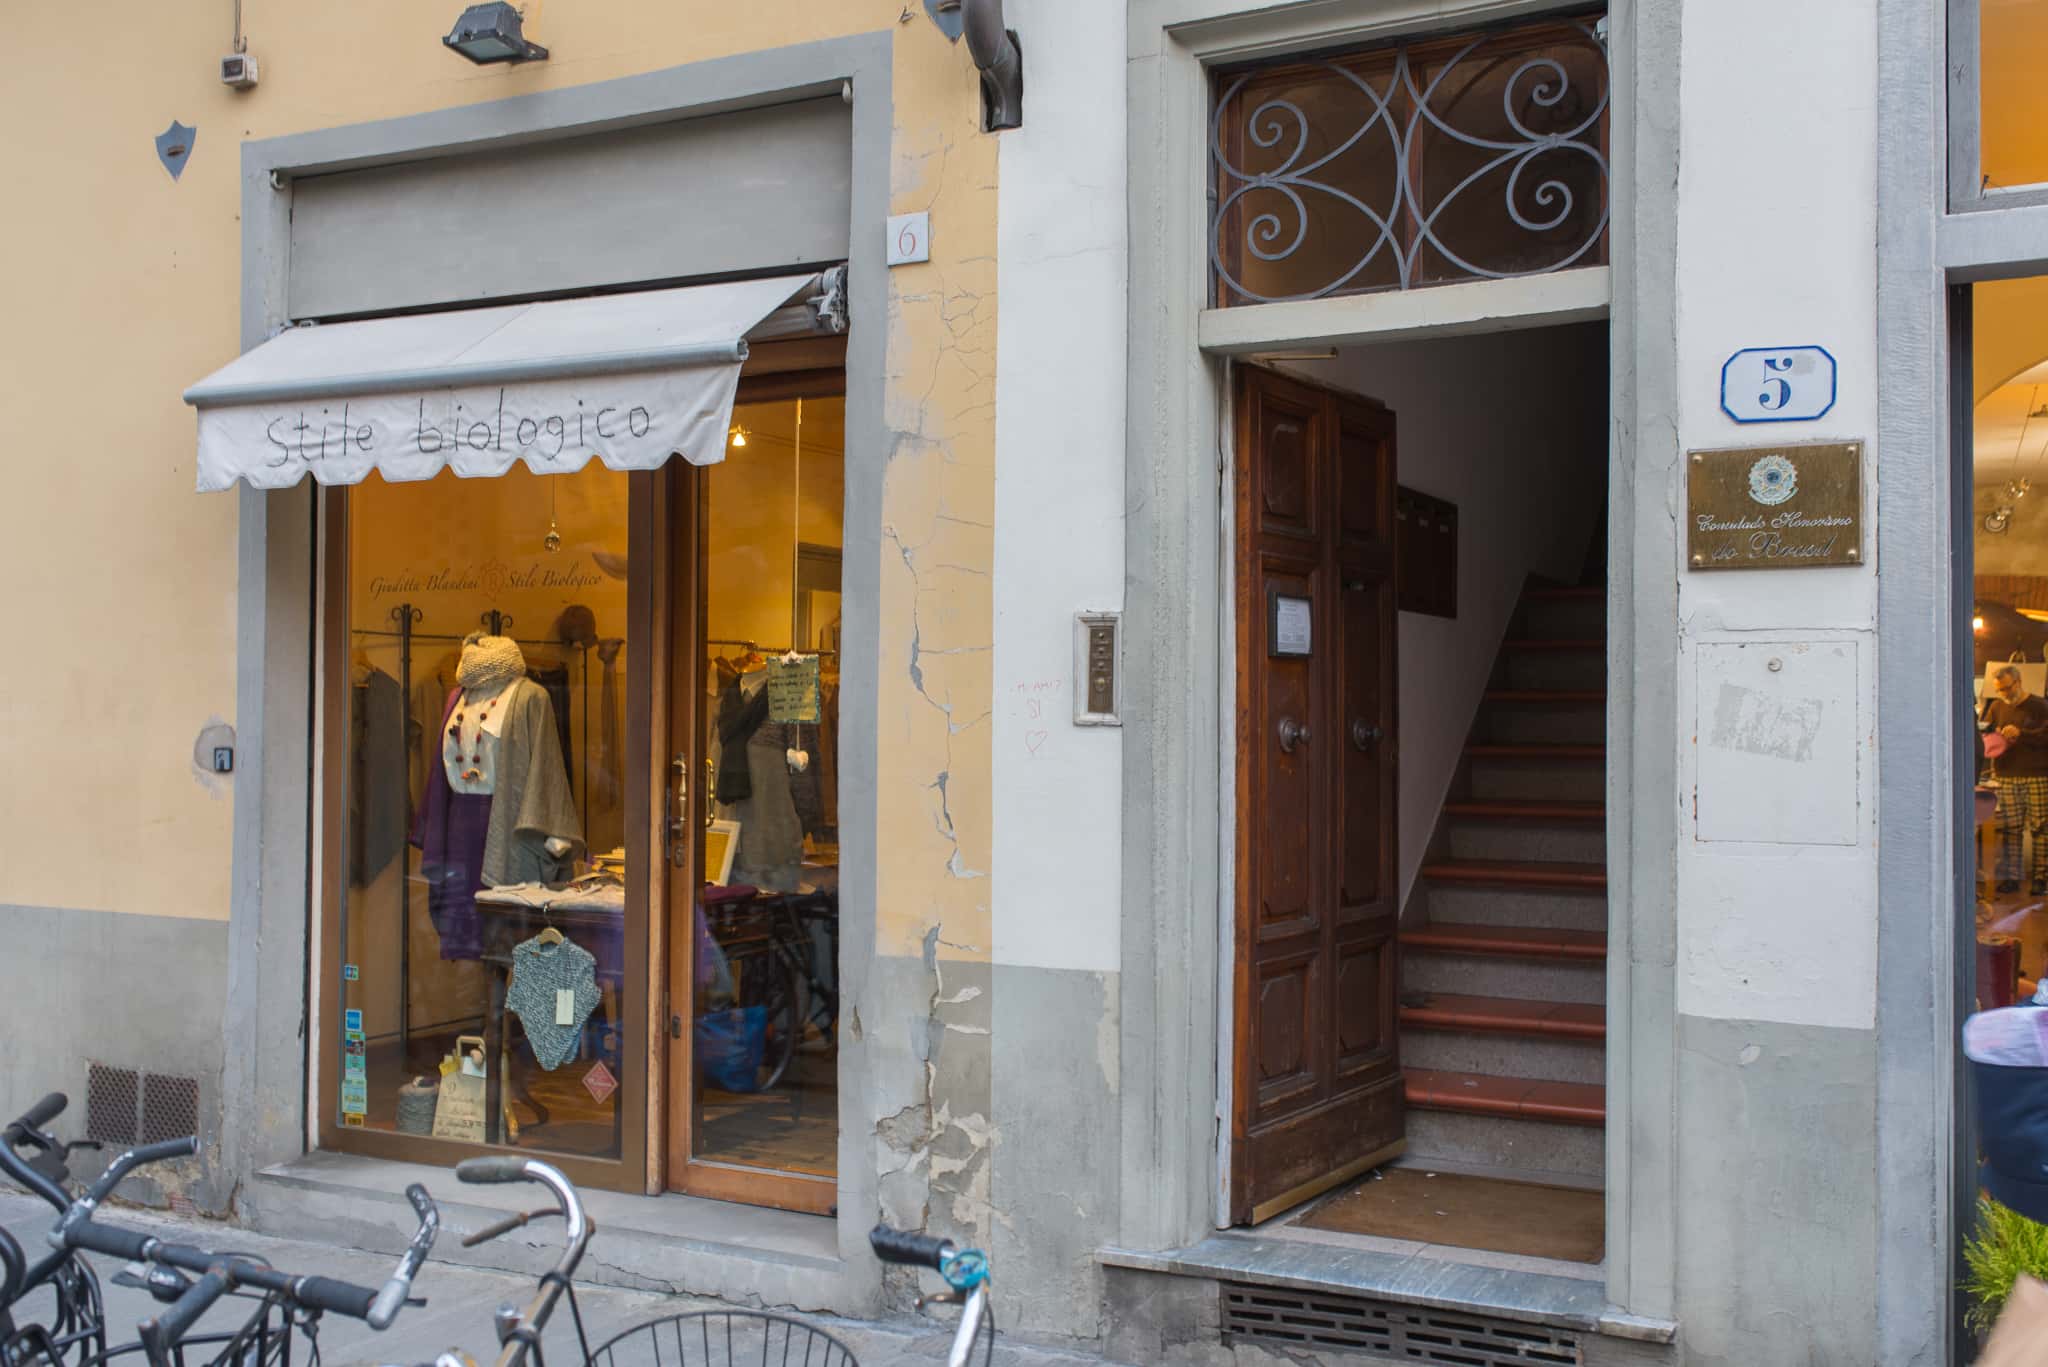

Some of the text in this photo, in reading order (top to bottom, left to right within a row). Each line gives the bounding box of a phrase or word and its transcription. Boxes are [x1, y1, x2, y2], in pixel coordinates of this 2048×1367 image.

[898, 221, 916, 257] 6
[1758, 357, 1793, 411] 5
[267, 387, 651, 468] Stile biologico
[1696, 513, 1766, 532] Consulado
[1711, 530, 1838, 560] do Brasil
[369, 567, 420, 600] Giuditta
[508, 563, 538, 588] Stile
[541, 560, 601, 592] Biologico
